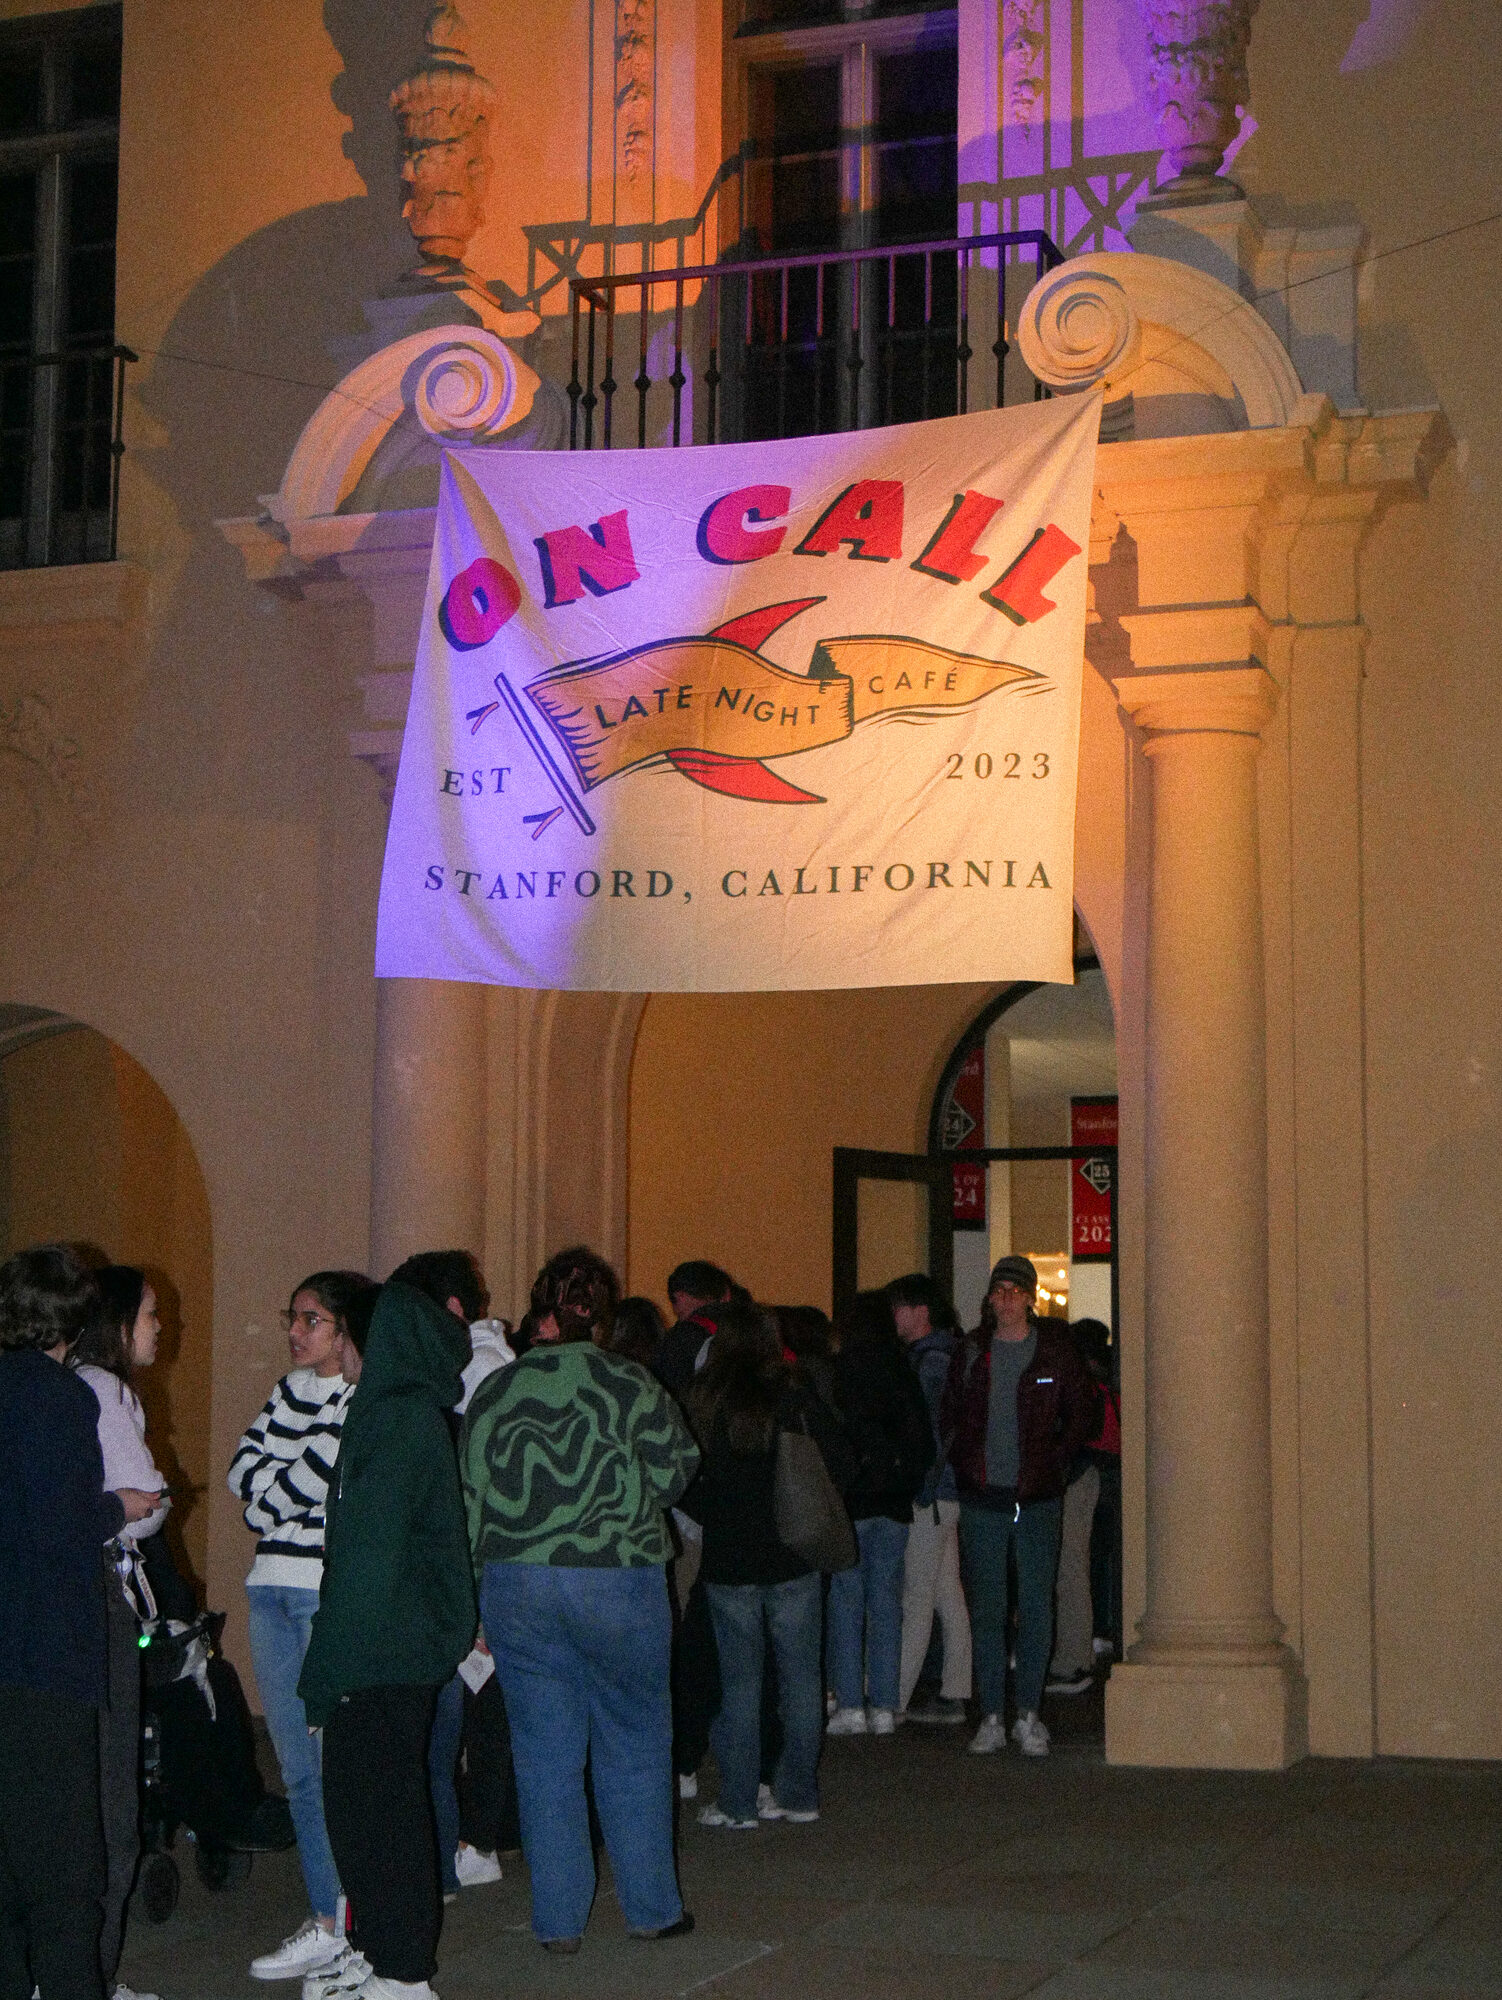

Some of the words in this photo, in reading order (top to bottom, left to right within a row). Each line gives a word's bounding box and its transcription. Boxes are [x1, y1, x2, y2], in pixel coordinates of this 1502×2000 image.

[438, 509, 641, 653] ON
[696, 479, 1082, 626] CALL
[868, 667, 958, 694] CAFÉ
[595, 685, 693, 729] LATE
[714, 686, 820, 727] NIGHT
[946, 752, 1050, 780] 2023
[439, 766, 511, 797] EST
[424, 865, 692, 904] STANFORD,
[721, 860, 1053, 897] CALIFORNIA
[954, 1188, 977, 1206] 24
[1079, 1226, 1111, 1242] 202
